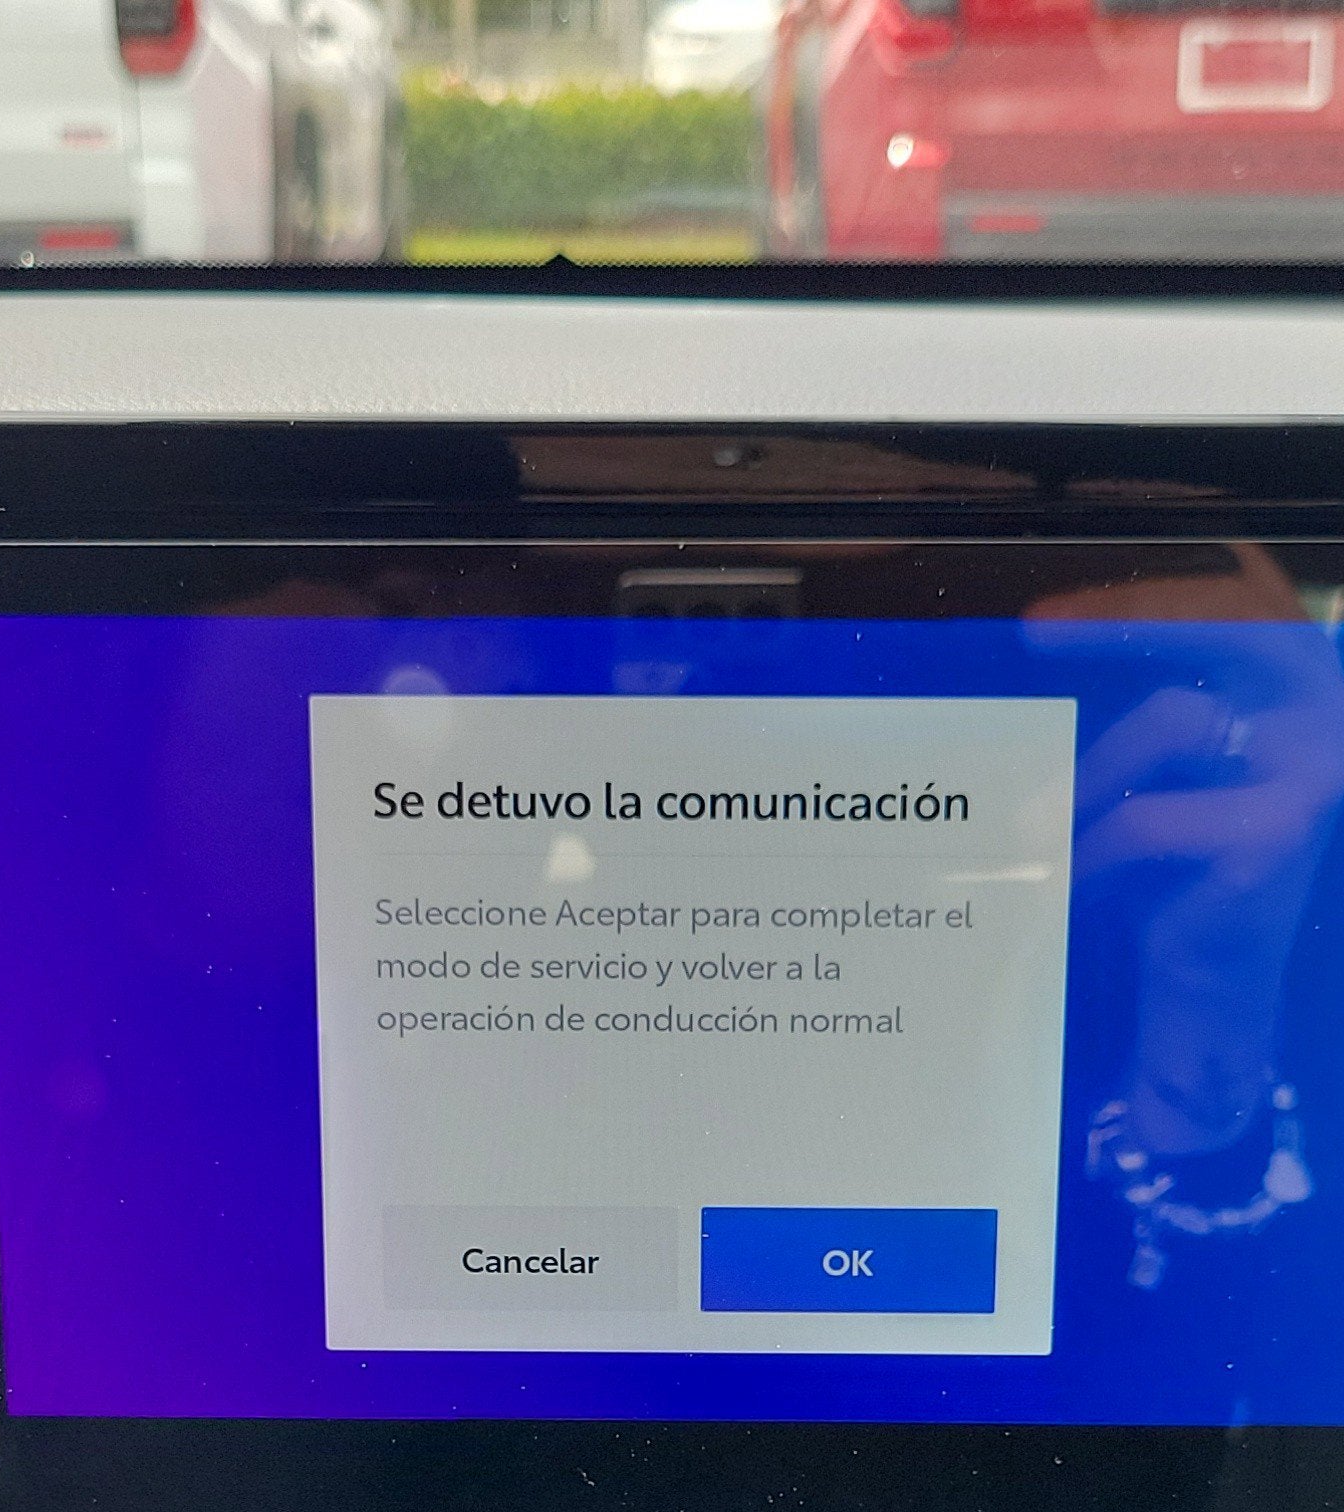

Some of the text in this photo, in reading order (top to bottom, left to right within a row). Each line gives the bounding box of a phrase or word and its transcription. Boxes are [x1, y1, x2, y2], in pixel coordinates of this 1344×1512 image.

[372, 781, 970, 823] Se detuvo la comunicación
[374, 898, 973, 937] Seleccione Aceptar para completar el
[375, 951, 842, 987] modo de servicio y volver a la
[376, 1004, 904, 1040] operación de conducción normal
[461, 1247, 600, 1276] Cancelar
[822, 1249, 875, 1277] OK
